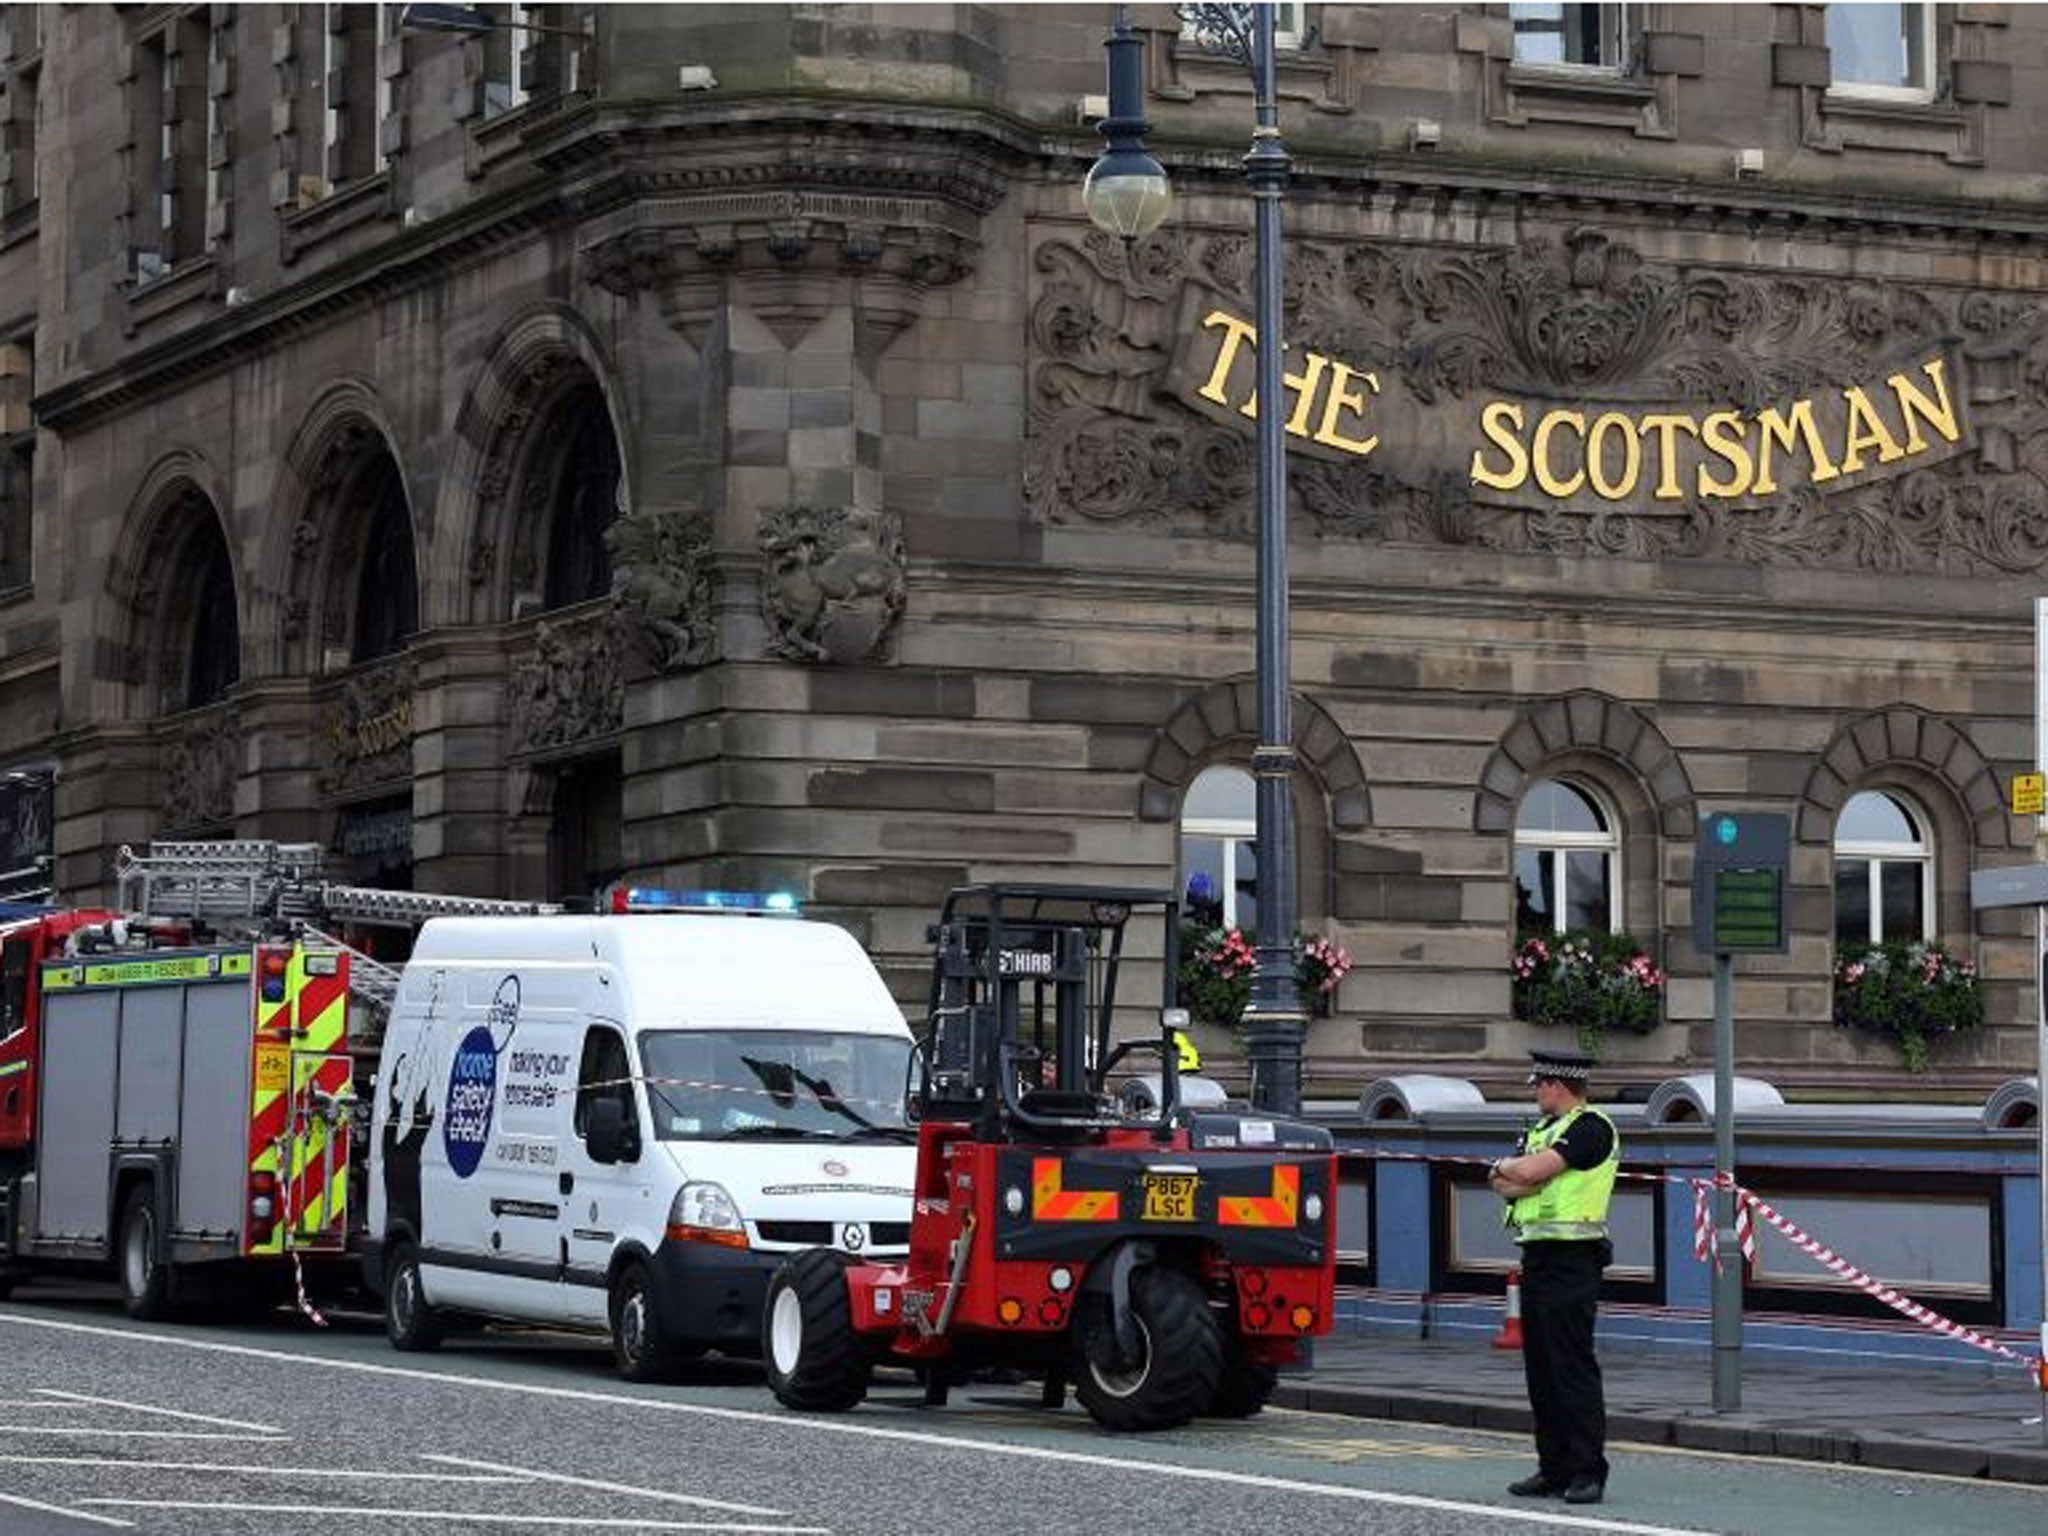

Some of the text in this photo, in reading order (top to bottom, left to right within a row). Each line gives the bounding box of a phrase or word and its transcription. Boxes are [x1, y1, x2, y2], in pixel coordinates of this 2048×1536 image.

[1198, 311, 1962, 500] THE SCOTSMAN
[1015, 953, 1052, 974] HIAB
[1146, 1176, 1193, 1196] P867
[1151, 1197, 1186, 1217] LSC
